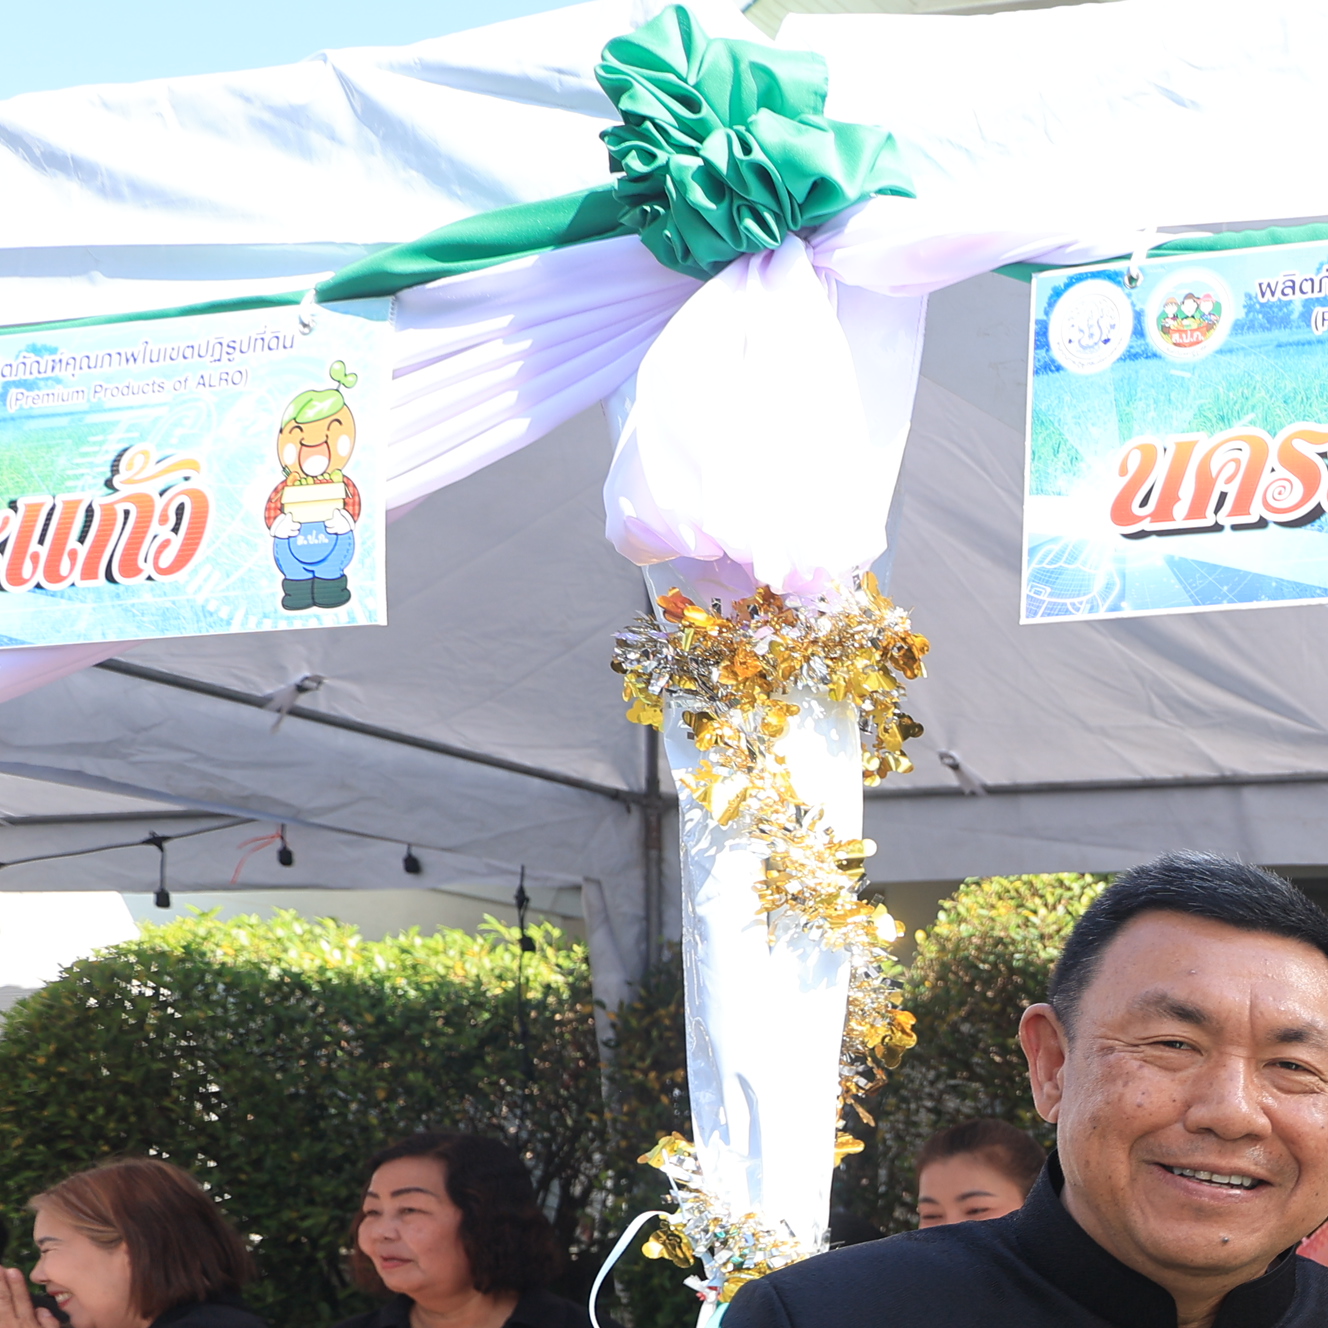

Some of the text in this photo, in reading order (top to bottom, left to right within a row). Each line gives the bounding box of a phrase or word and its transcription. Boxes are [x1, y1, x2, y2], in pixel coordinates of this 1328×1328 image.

[9, 369, 249, 411] (Premium Products of ALRO)
